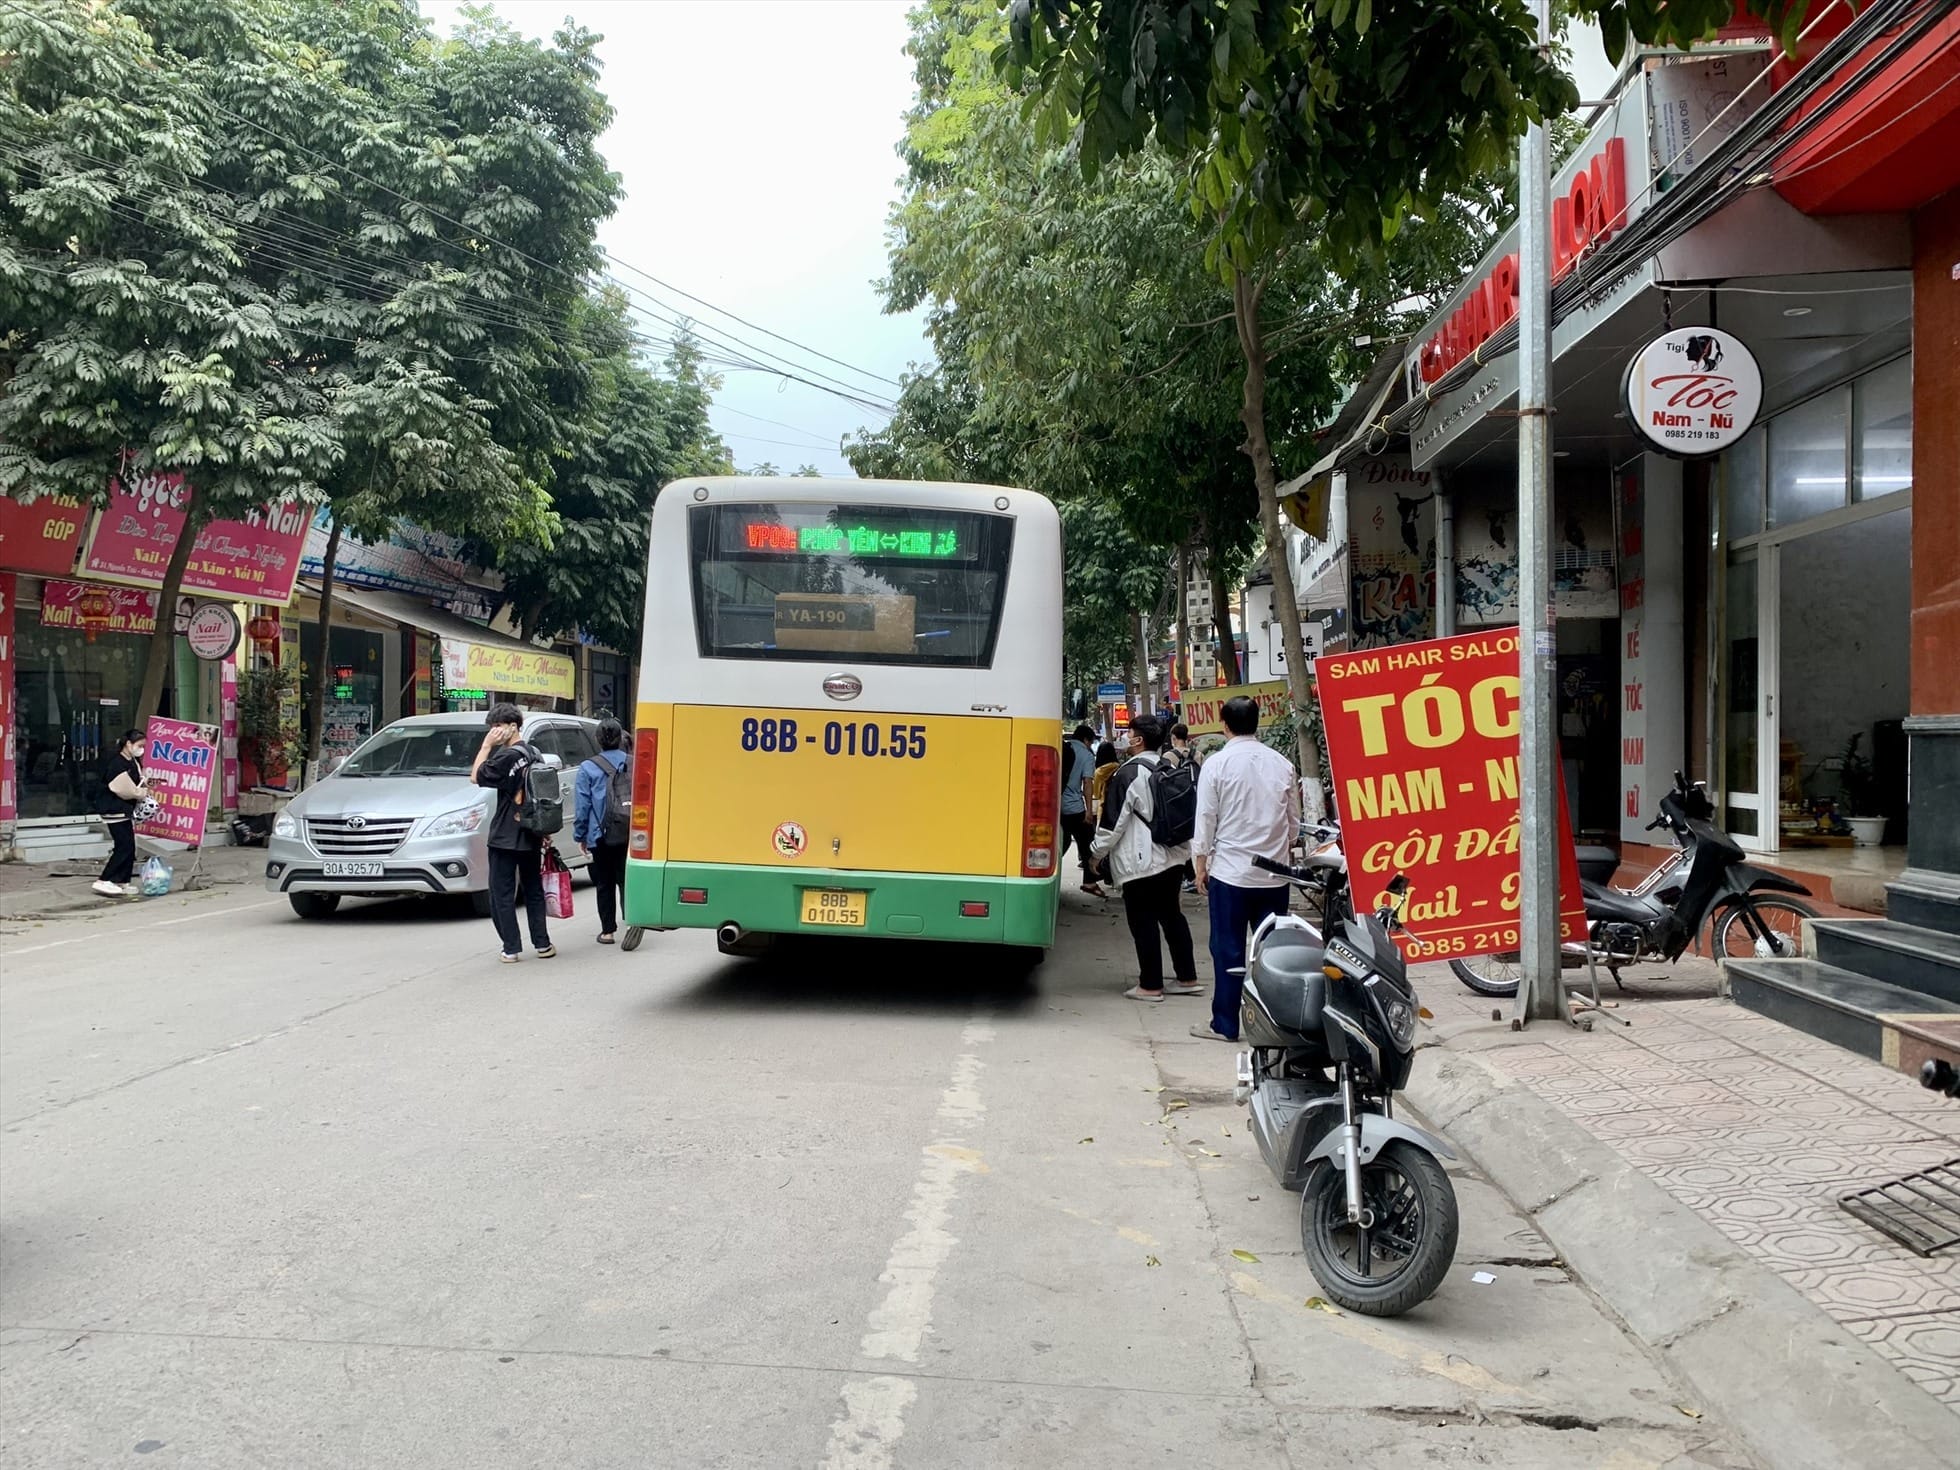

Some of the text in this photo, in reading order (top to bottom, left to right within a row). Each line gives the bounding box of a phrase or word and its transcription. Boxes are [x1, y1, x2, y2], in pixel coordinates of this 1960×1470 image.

[1680, 100, 1688, 116] ISO
[1665, 343, 1685, 352] Tigi
[1651, 374, 1738, 409] Tóc
[1652, 411, 1691, 427] Nam
[1665, 430, 1685, 438] 0985
[1706, 431, 1720, 439] 183
[43, 517, 76, 541] GÓP
[265, 502, 304, 537] Nail
[847, 526, 878, 552] YÊN
[134, 548, 160, 564] Nail
[44, 604, 72, 623] Nail
[128, 612, 156, 631] Xăm
[789, 609, 846, 623] YA-190
[195, 622, 222, 634] Nail
[1330, 658, 1380, 679] SAM
[1387, 649, 1444, 671] HAIR
[1625, 676, 1643, 711] TÓC
[1186, 696, 1214, 726] BÚN
[1342, 672, 1519, 757] TÓC
[741, 717, 797, 752] 88B
[824, 721, 926, 759] 010.55
[151, 739, 209, 770] Nail
[1623, 737, 1644, 766] NAM
[181, 771, 207, 793] XĂM
[1346, 767, 1446, 821] NAM
[1485, 755, 1519, 802] N
[176, 815, 193, 829] MI
[821, 894, 848, 907] 88B
[808, 908, 859, 923] 010.55
[1406, 929, 1518, 958] 0985 219
